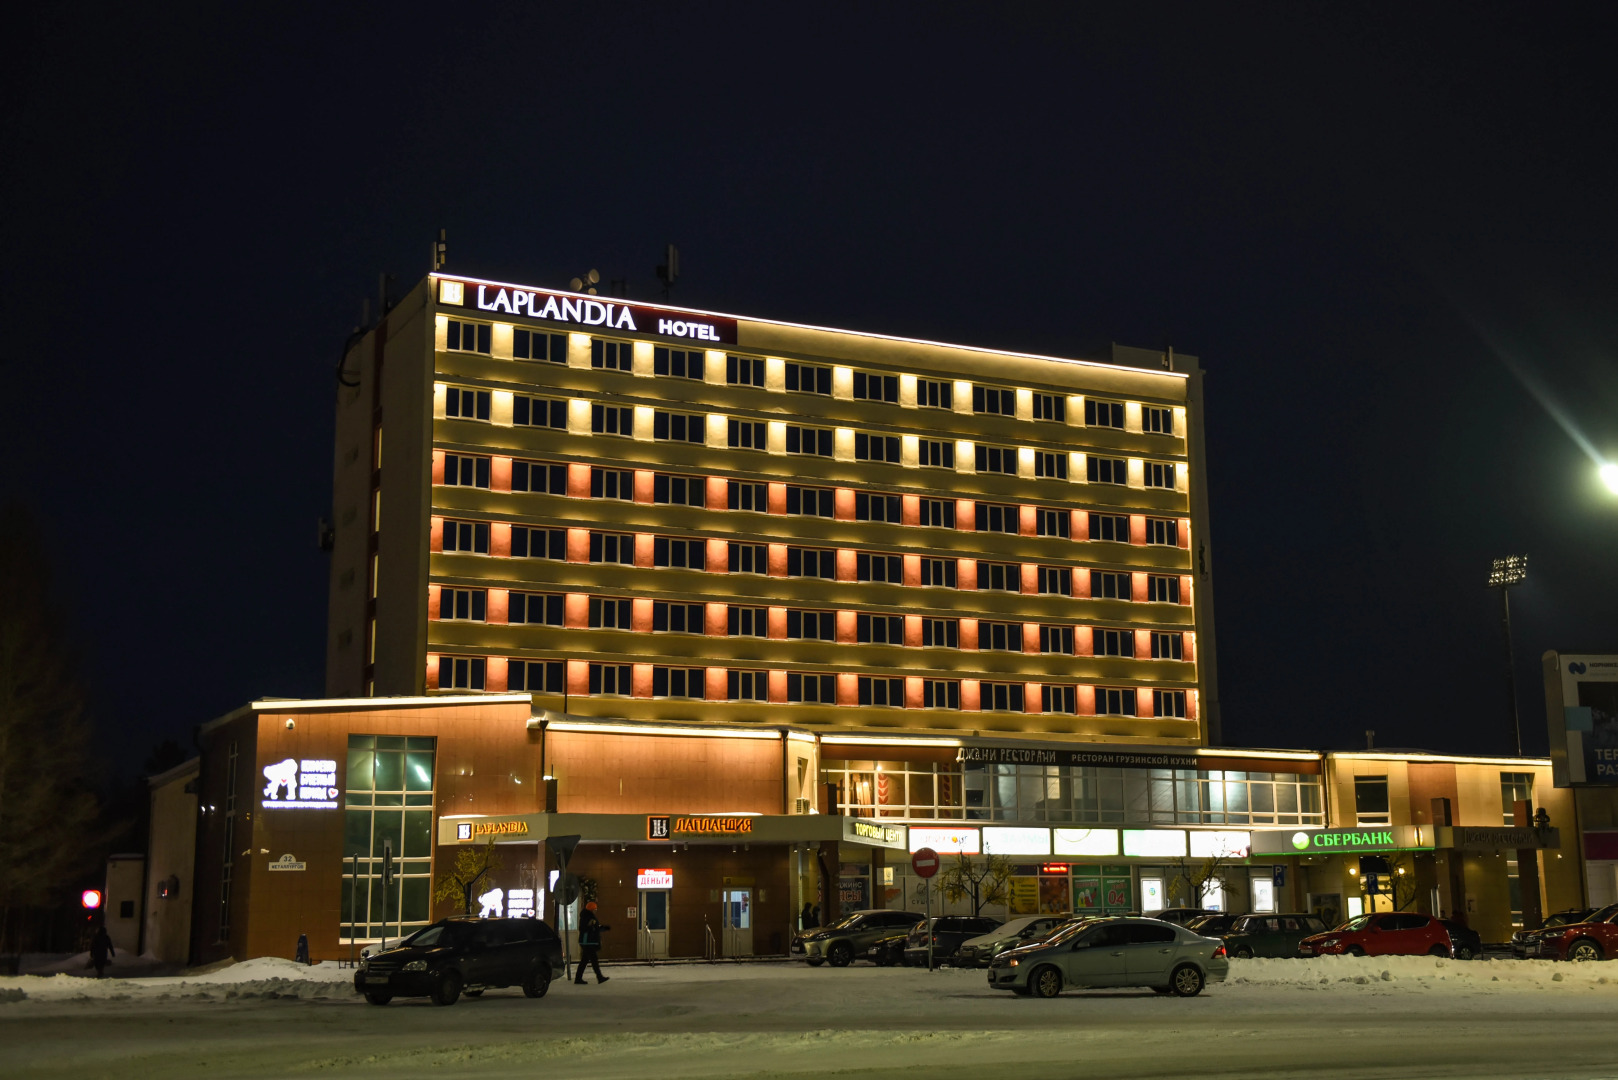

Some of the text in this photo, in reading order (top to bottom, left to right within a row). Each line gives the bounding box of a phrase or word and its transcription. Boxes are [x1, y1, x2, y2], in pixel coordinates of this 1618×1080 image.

[477, 285, 721, 342] LAPLANDIA HOTEL
[1000, 748, 1057, 763] РЕСТОРАНИ
[1071, 754, 1197, 766] РЕСТОРАН ГРУЗИНСКОЙ КУХНИ
[475, 821, 529, 835] LAPLANDIA
[674, 818, 752, 833] ЛАПЛАНДИЯ
[855, 822, 885, 840] ТОРГОВЫЙ
[885, 828, 902, 843] ЦЕНТР
[1313, 831, 1394, 847] СБЕРБАНК
[641, 876, 670, 886] ДЕНЬГИ
[1107, 890, 1126, 906] 04
